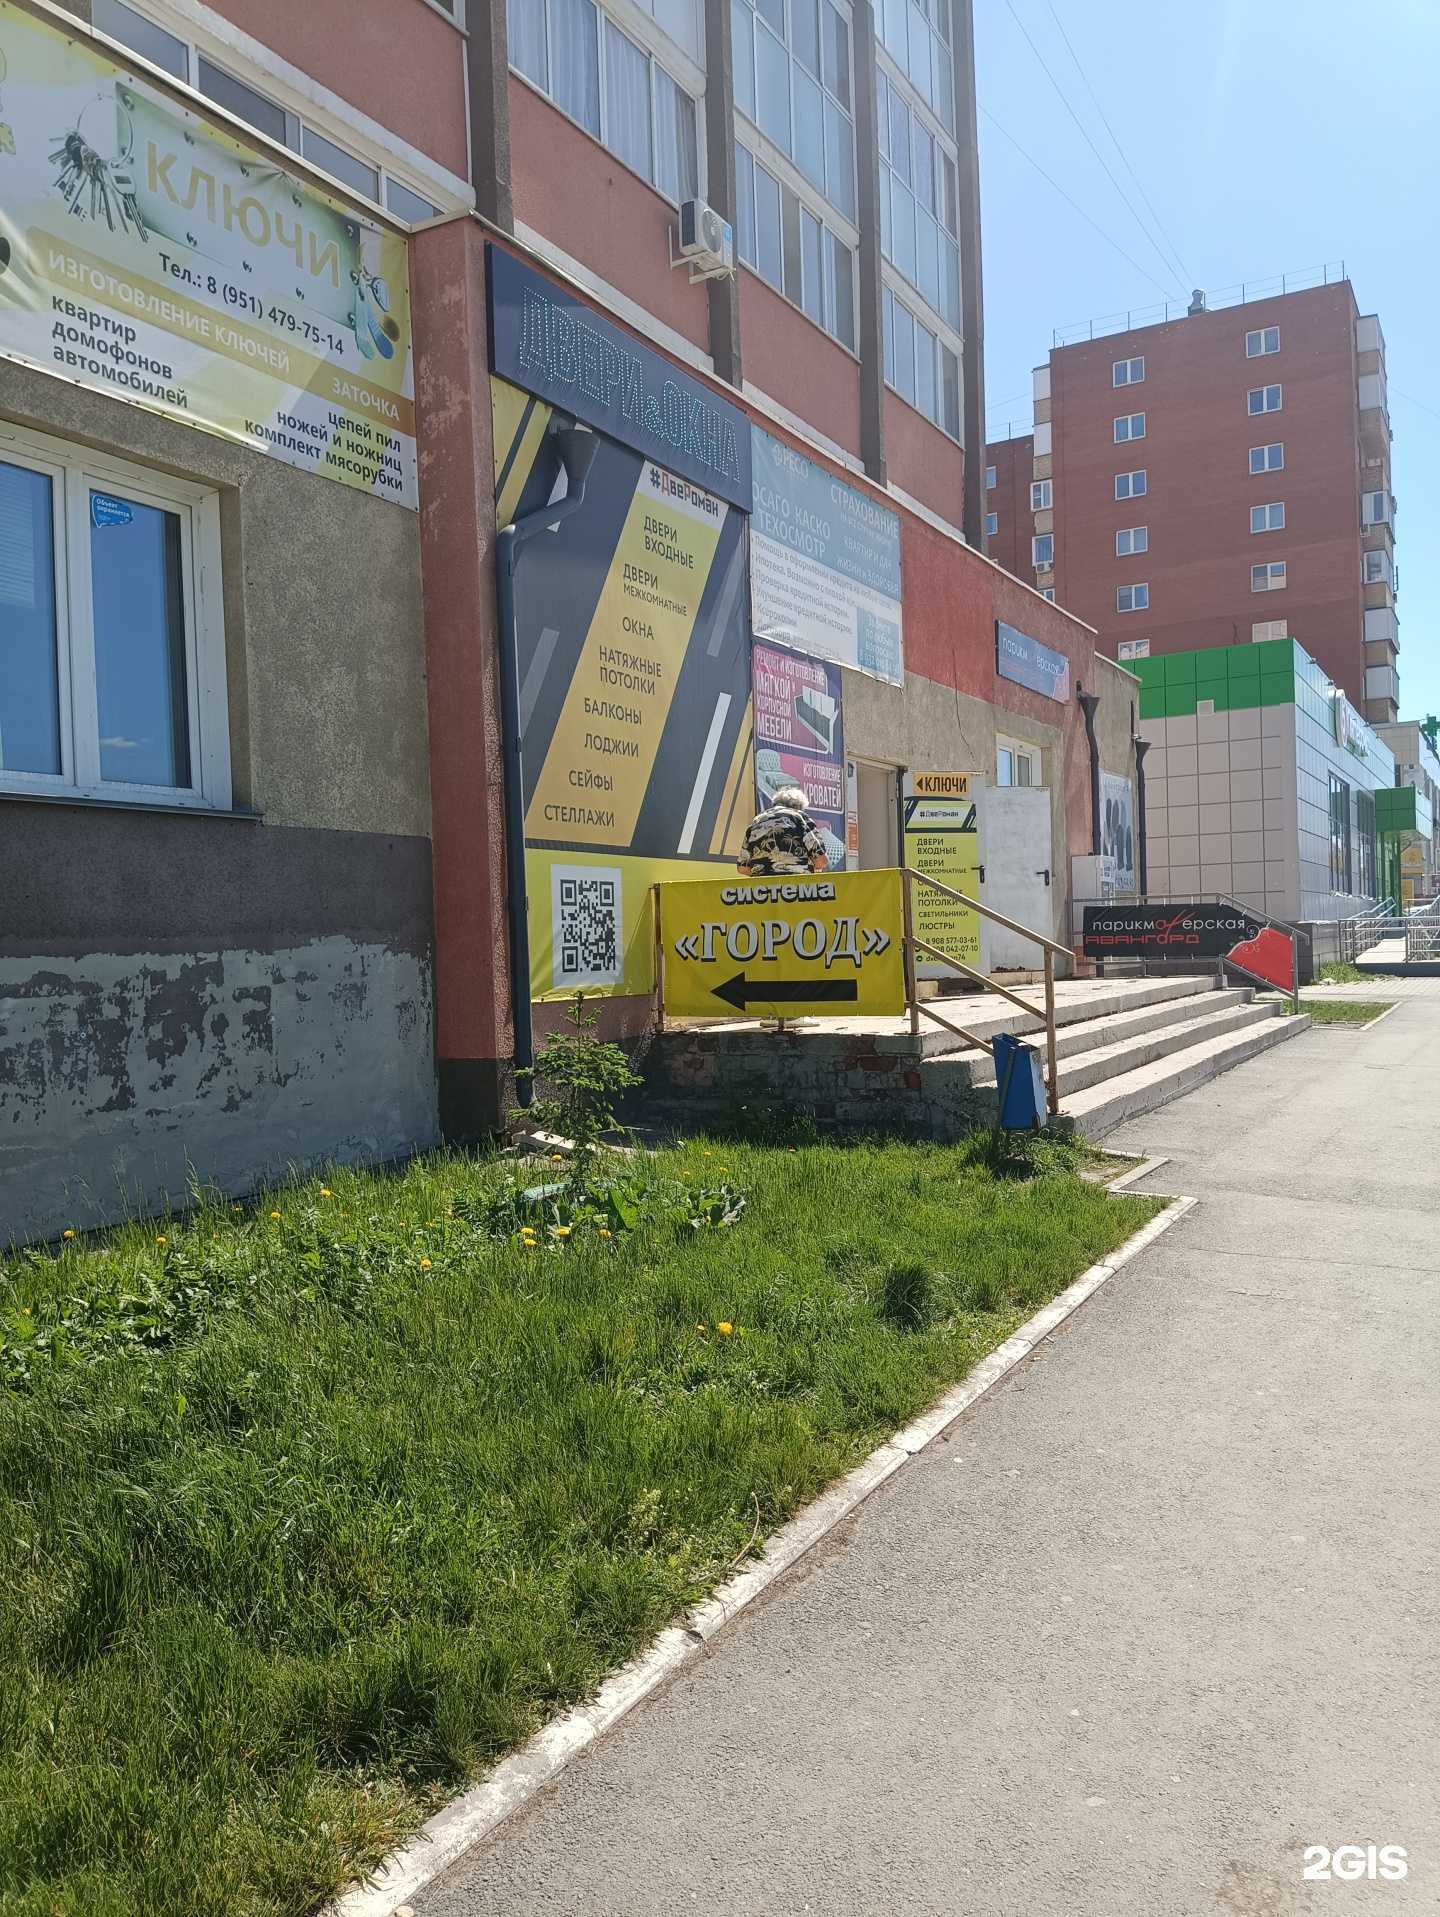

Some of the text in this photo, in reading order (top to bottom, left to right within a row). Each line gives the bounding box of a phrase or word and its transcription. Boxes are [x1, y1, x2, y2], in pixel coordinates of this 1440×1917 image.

[146, 140, 341, 289] КЛЮЧИ
[49, 249, 290, 373] ИЗГОТОВЛЕНИЕ КЛЮЧЕЙ
[158, 251, 345, 355] Тел.: 8 (951) 479-75-14
[52, 295, 137, 345] квартир
[52, 320, 173, 380] домофонов
[53, 344, 188, 409] автомобилей
[332, 376, 400, 422] ЗАТОЧКА
[277, 411, 328, 442] ножей
[346, 438, 403, 476] ножниц
[328, 411, 401, 453] цепей пил
[244, 419, 403, 492] комплект мясорубки
[794, 506, 831, 539] КАСКО
[830, 484, 899, 539] СТРАХОВАНИЕ
[644, 515, 678, 543] ДВЕРИ
[757, 507, 826, 558] ТЕХОСМОТР
[644, 535, 694, 570] ВХОДНЫЕ
[622, 562, 658, 590] ДВЕРИ
[623, 583, 687, 617] МЕЖКОМНАТНЫЕ
[622, 616, 655, 641] ОКНА
[599, 644, 662, 678] НАТЯЖНЫЕ
[599, 666, 656, 695] ПОТОЛКИ
[756, 671, 791, 702] МЯГКОЙ
[583, 697, 642, 726] БАЛКОНЫ
[756, 711, 792, 741] МЕБЕЛИ
[583, 732, 640, 758] ЛОДЖИИ
[568, 768, 613, 792] СЕЙФЫ
[803, 761, 841, 783] ИЗГОТОВЛЕНИЕ
[924, 776, 967, 793] КЛЮЧИ
[803, 781, 842, 808] КРОВАТЕЙ
[543, 804, 615, 828] СТЕЛЛАЖИ
[916, 838, 944, 846] ДВЕРИ
[917, 847, 957, 855] ВХОДНЫЕ
[917, 859, 945, 867] ДВЕРИ
[720, 881, 836, 905] система
[918, 899, 958, 907] ПОТОЛКИ
[919, 922, 955, 930] ЛЮСТРЫ
[674, 916, 891, 969] «ГОРОД»
